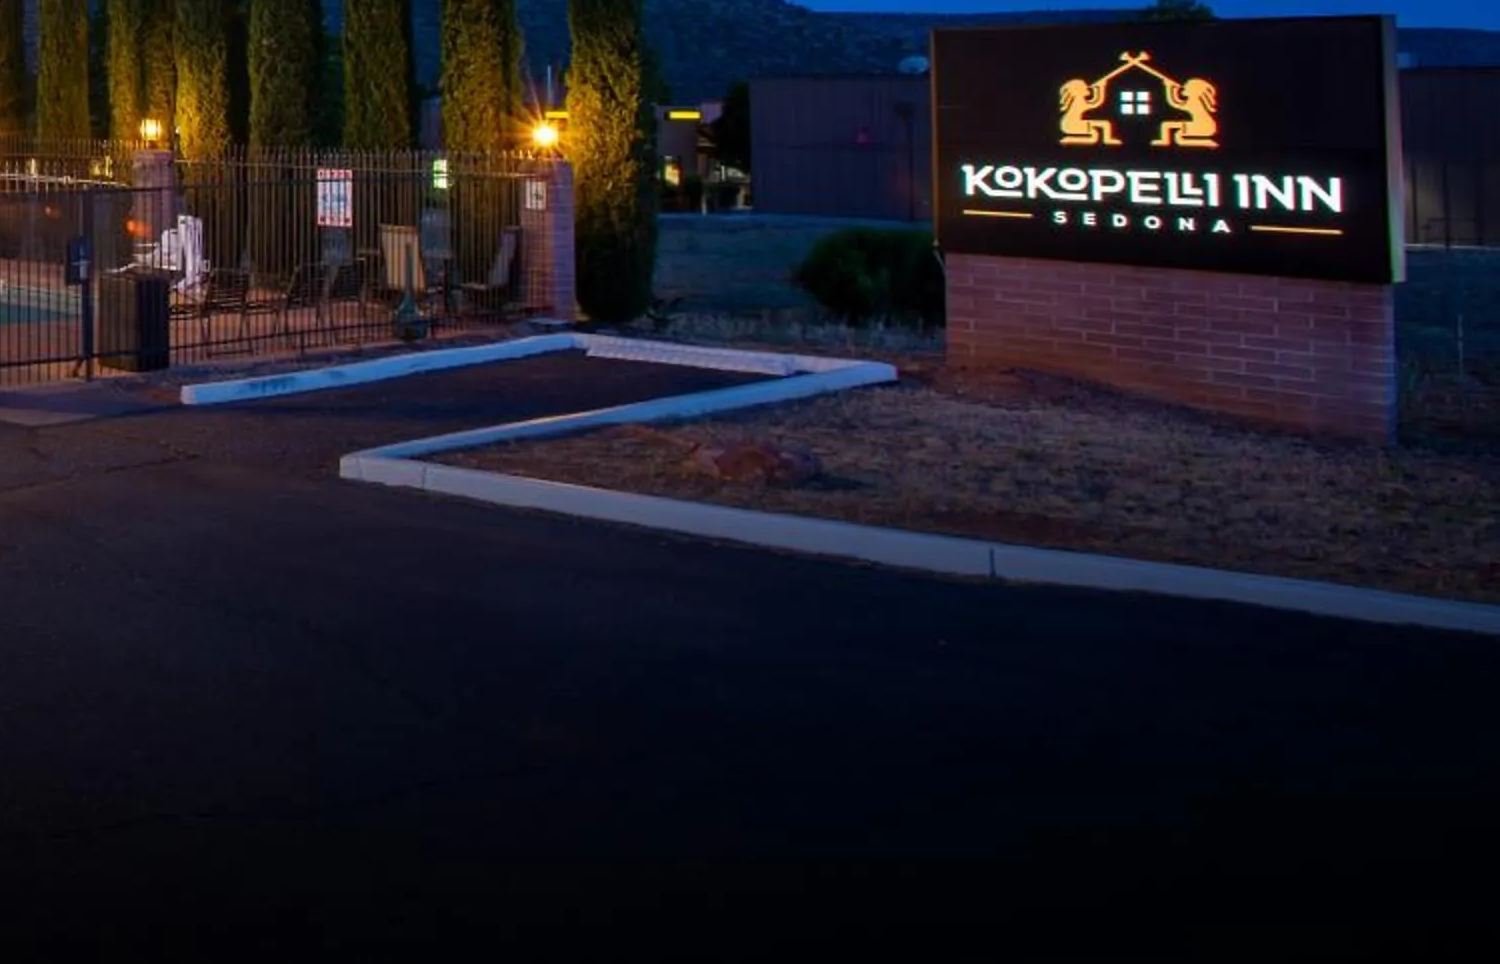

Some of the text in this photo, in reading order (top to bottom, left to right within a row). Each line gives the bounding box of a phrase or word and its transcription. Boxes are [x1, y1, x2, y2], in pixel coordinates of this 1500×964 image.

[961, 164, 1342, 213] KOKOPELLI INN
[1053, 211, 1231, 233] SEDONA
